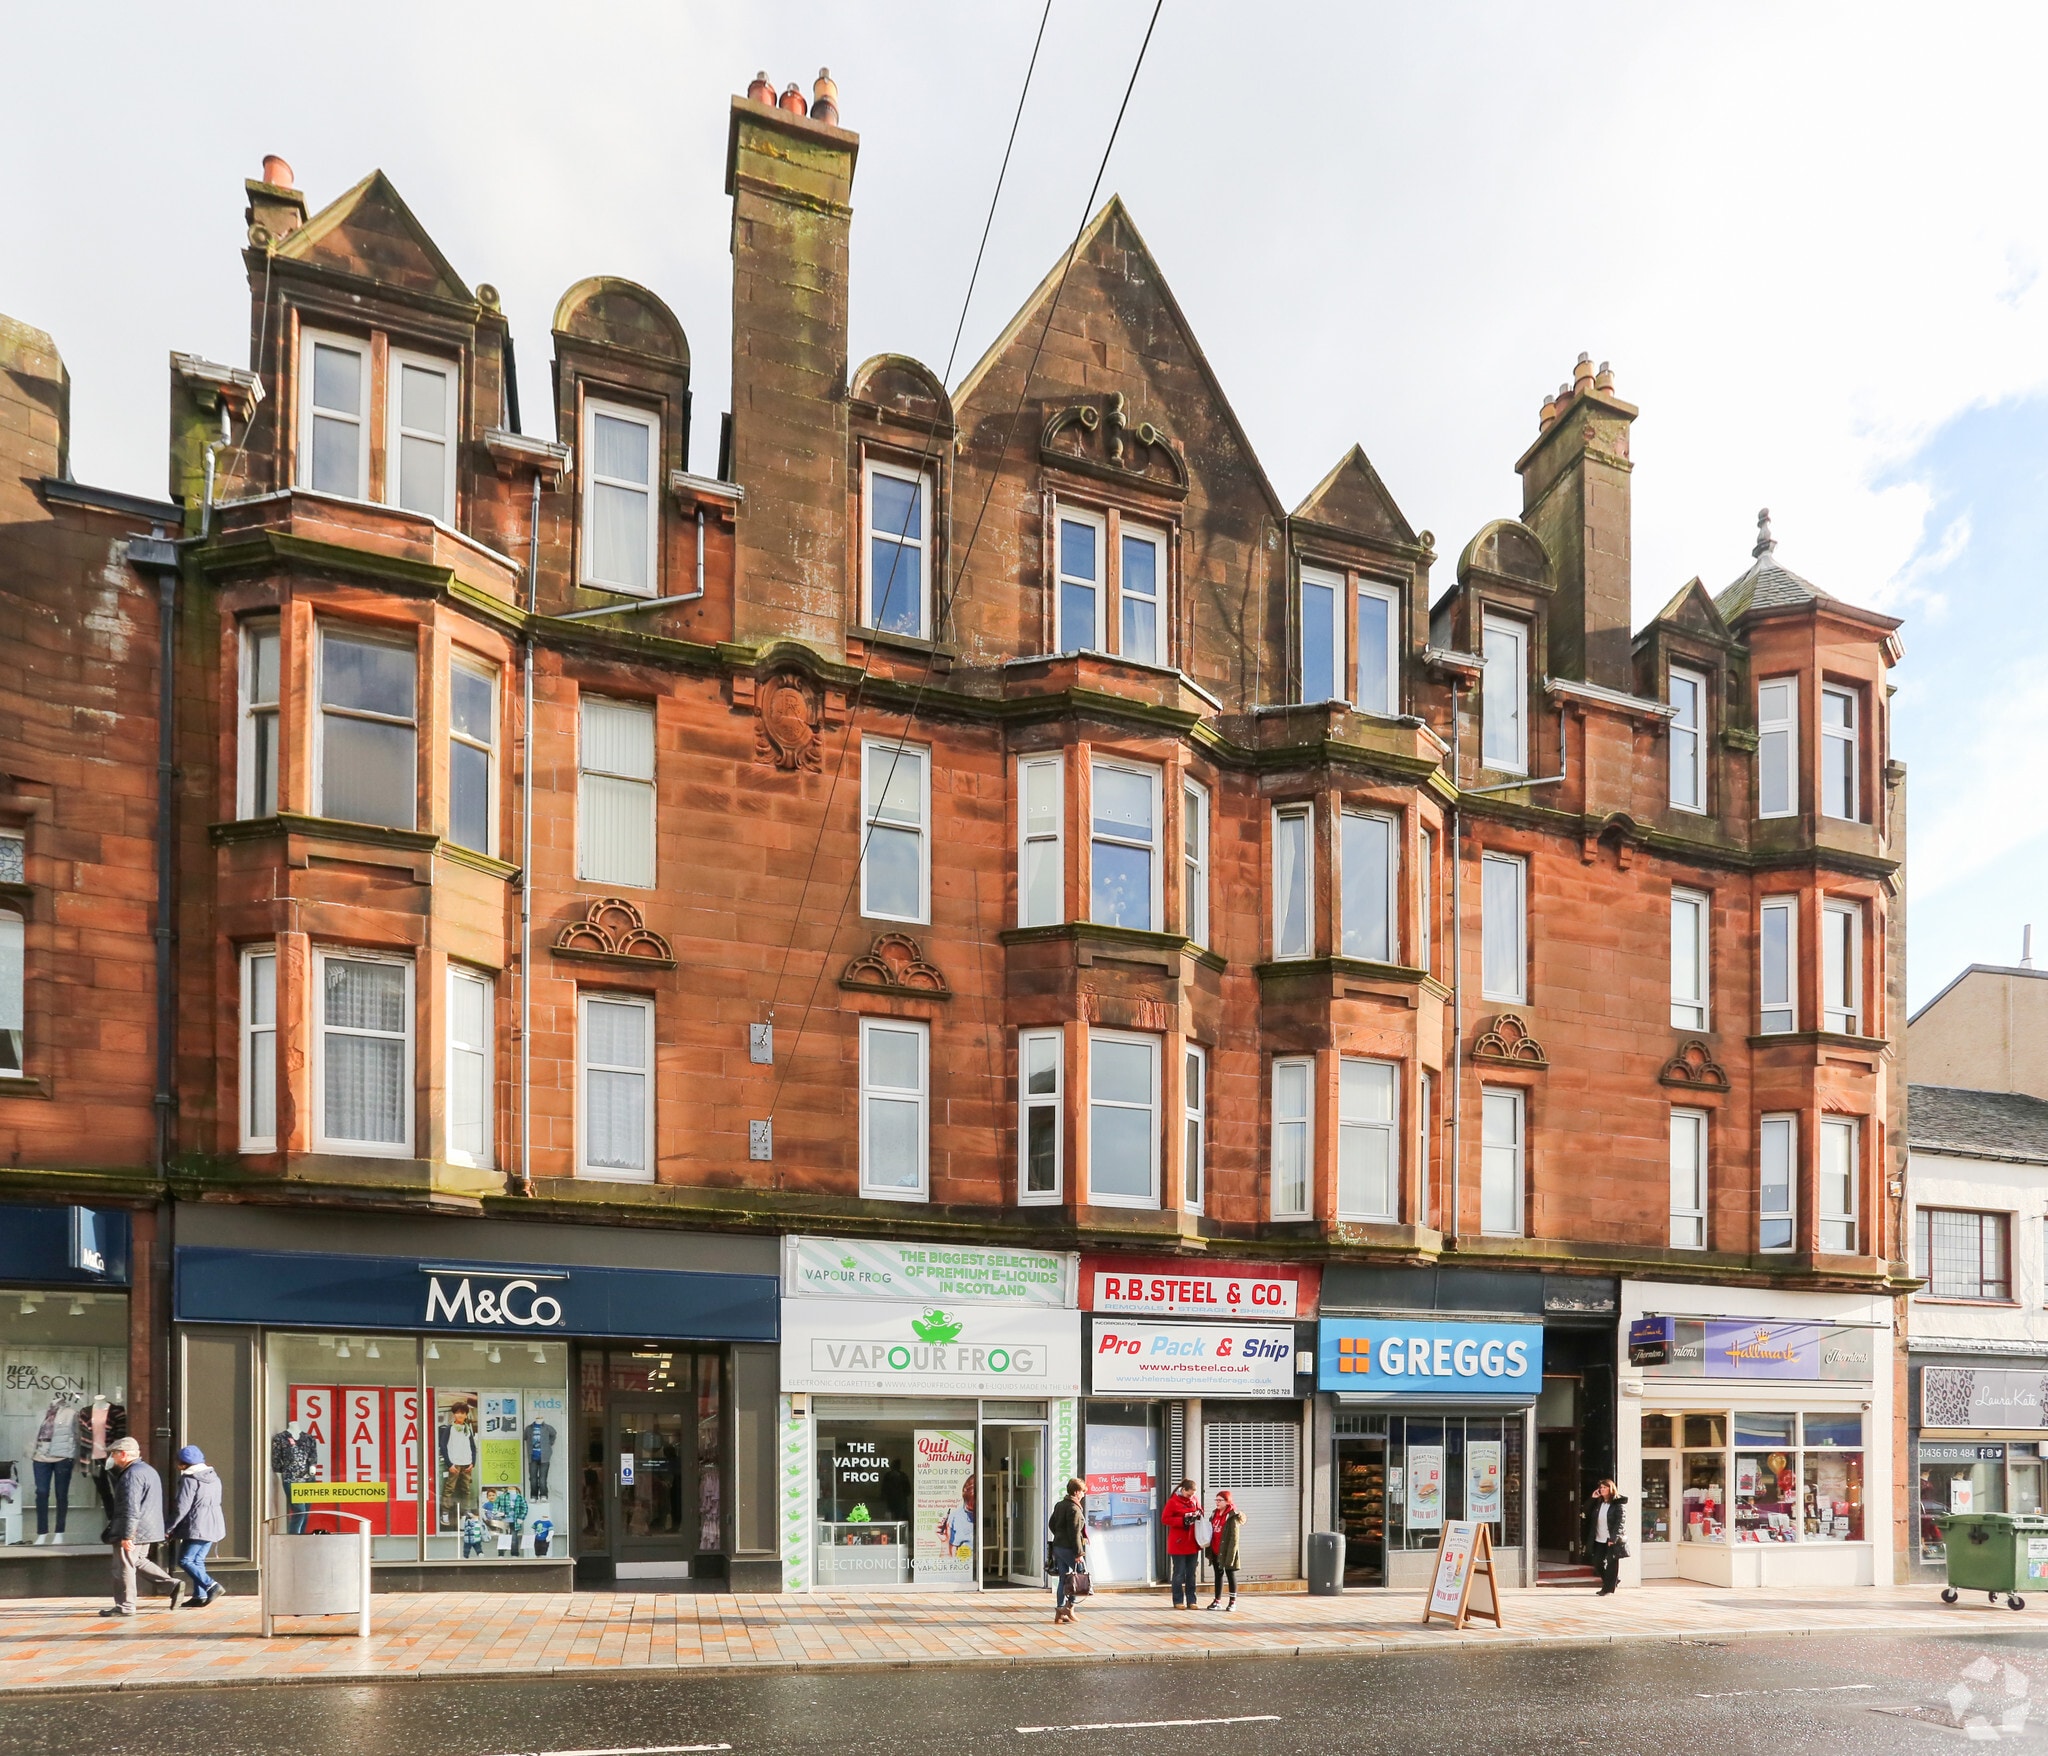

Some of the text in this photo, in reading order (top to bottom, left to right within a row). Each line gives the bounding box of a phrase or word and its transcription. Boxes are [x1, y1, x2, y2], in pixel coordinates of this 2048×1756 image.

[900, 1250, 1057, 1269] THE BIGGEST SELECTION
[806, 1269, 891, 1283] VAPOUR FROG
[905, 1266, 1057, 1283] OF PREMIUM E-LIQUIDS
[940, 1282, 1026, 1296] IN SCOTLAND
[1226, 1283, 1241, 1304] &
[1251, 1284, 1287, 1306] CO.
[426, 1277, 561, 1326] M&Co
[1099, 1334, 1289, 1362] Pro Pack & Ship
[1725, 1340, 1800, 1368] Hallmark
[826, 1344, 1033, 1372] VAPOUR FROG
[1379, 1337, 1528, 1378] GREGGS
[1825, 1348, 1867, 1364] Thorntons
[7, 1365, 38, 1375] new
[1139, 1363, 1250, 1372] www.rbsteel.co.uk
[6, 1375, 84, 1390] SEASON
[835, 1380, 876, 1388] CIGARETTES
[1975, 1386, 2037, 1406] Laura Kate
[401, 1398, 417, 1494] SALE
[847, 1443, 875, 1453] THE
[918, 1438, 949, 1454] Quit
[1059, 1401, 1072, 1482] ELECTRONIC
[927, 1451, 972, 1465] smoking
[1919, 1449, 1975, 1458] 01436 678 484
[832, 1457, 889, 1467] VAPOUR
[843, 1472, 879, 1482] FROG
[333, 1488, 385, 1496] REDUCTIONS
[818, 1559, 896, 1570] ELECTRONIC
